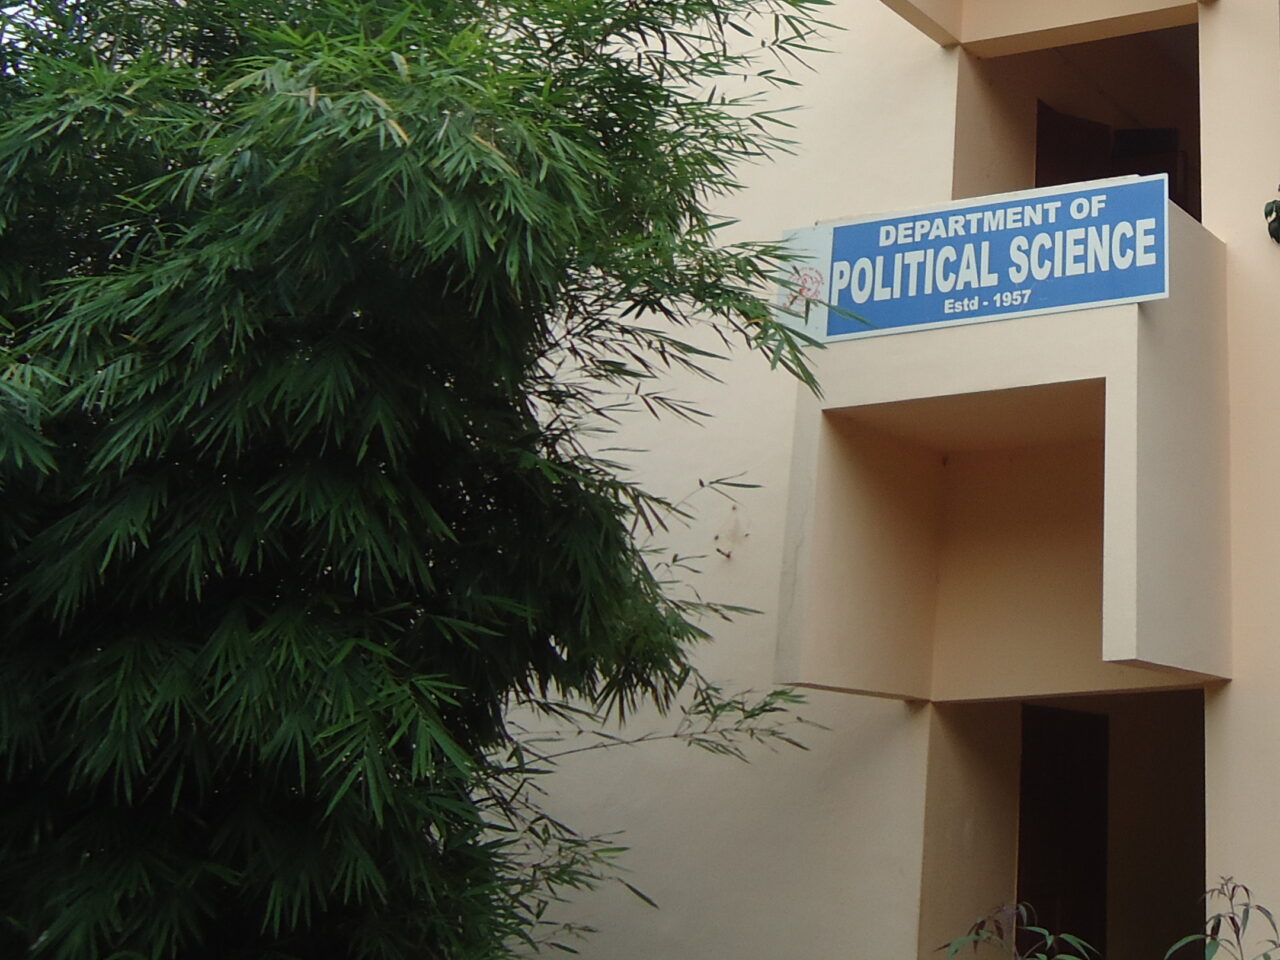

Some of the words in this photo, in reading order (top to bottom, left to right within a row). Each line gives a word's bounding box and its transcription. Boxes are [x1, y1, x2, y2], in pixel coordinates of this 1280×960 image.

[879, 201, 1062, 247] DEPARTMENT
[1070, 195, 1107, 220] OF
[831, 241, 998, 306] POLITICAL
[1008, 218, 1157, 285] SCIENCE
[944, 296, 979, 314] Estd
[993, 289, 1032, 308] 1957
